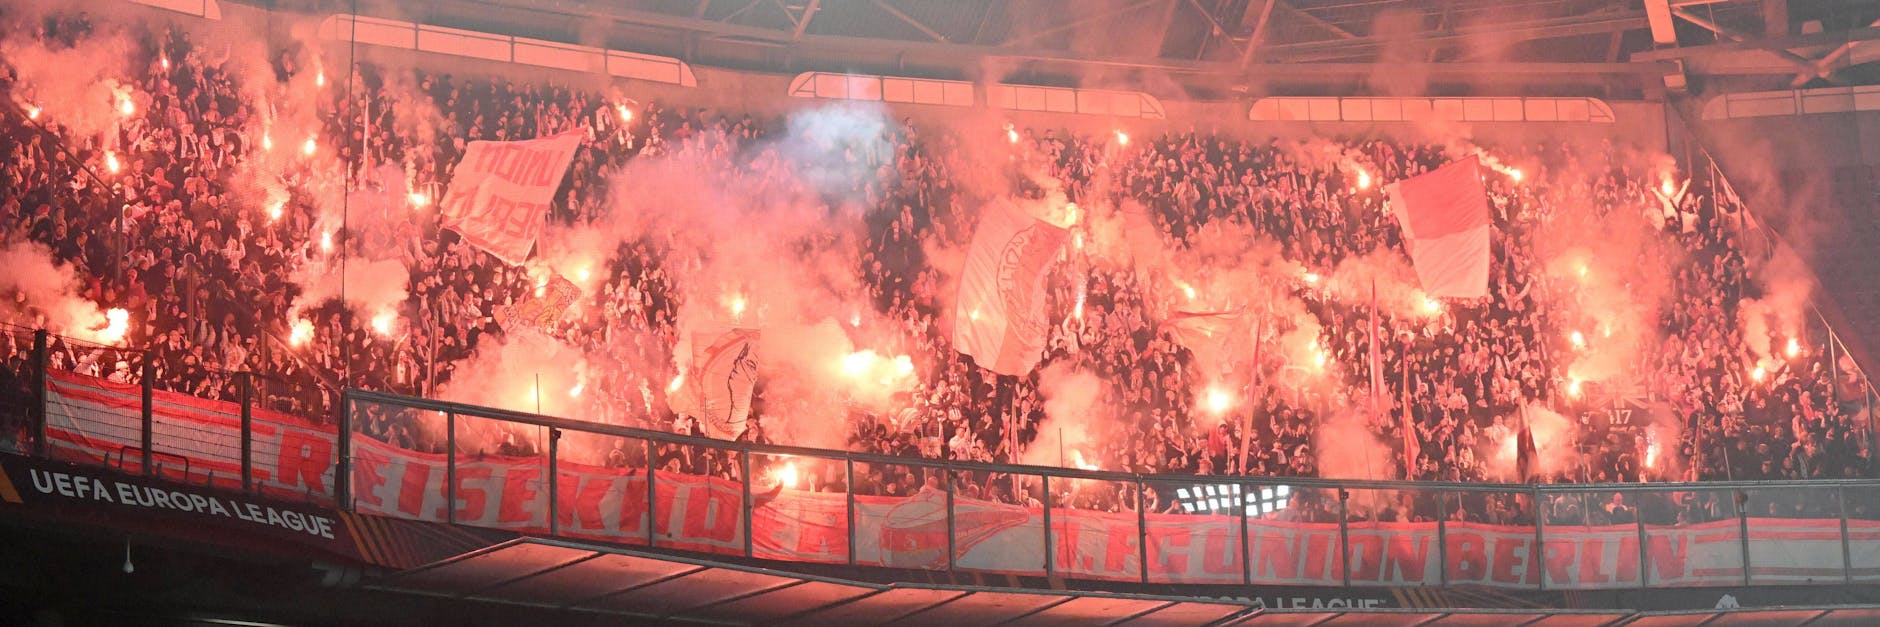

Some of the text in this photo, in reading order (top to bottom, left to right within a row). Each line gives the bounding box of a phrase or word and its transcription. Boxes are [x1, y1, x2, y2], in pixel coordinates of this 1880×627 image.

[30, 469, 336, 540] UEFA EUROPA LEAGUE
[1203, 527, 1430, 584] UNION
[1446, 532, 1689, 584] BERLIN
